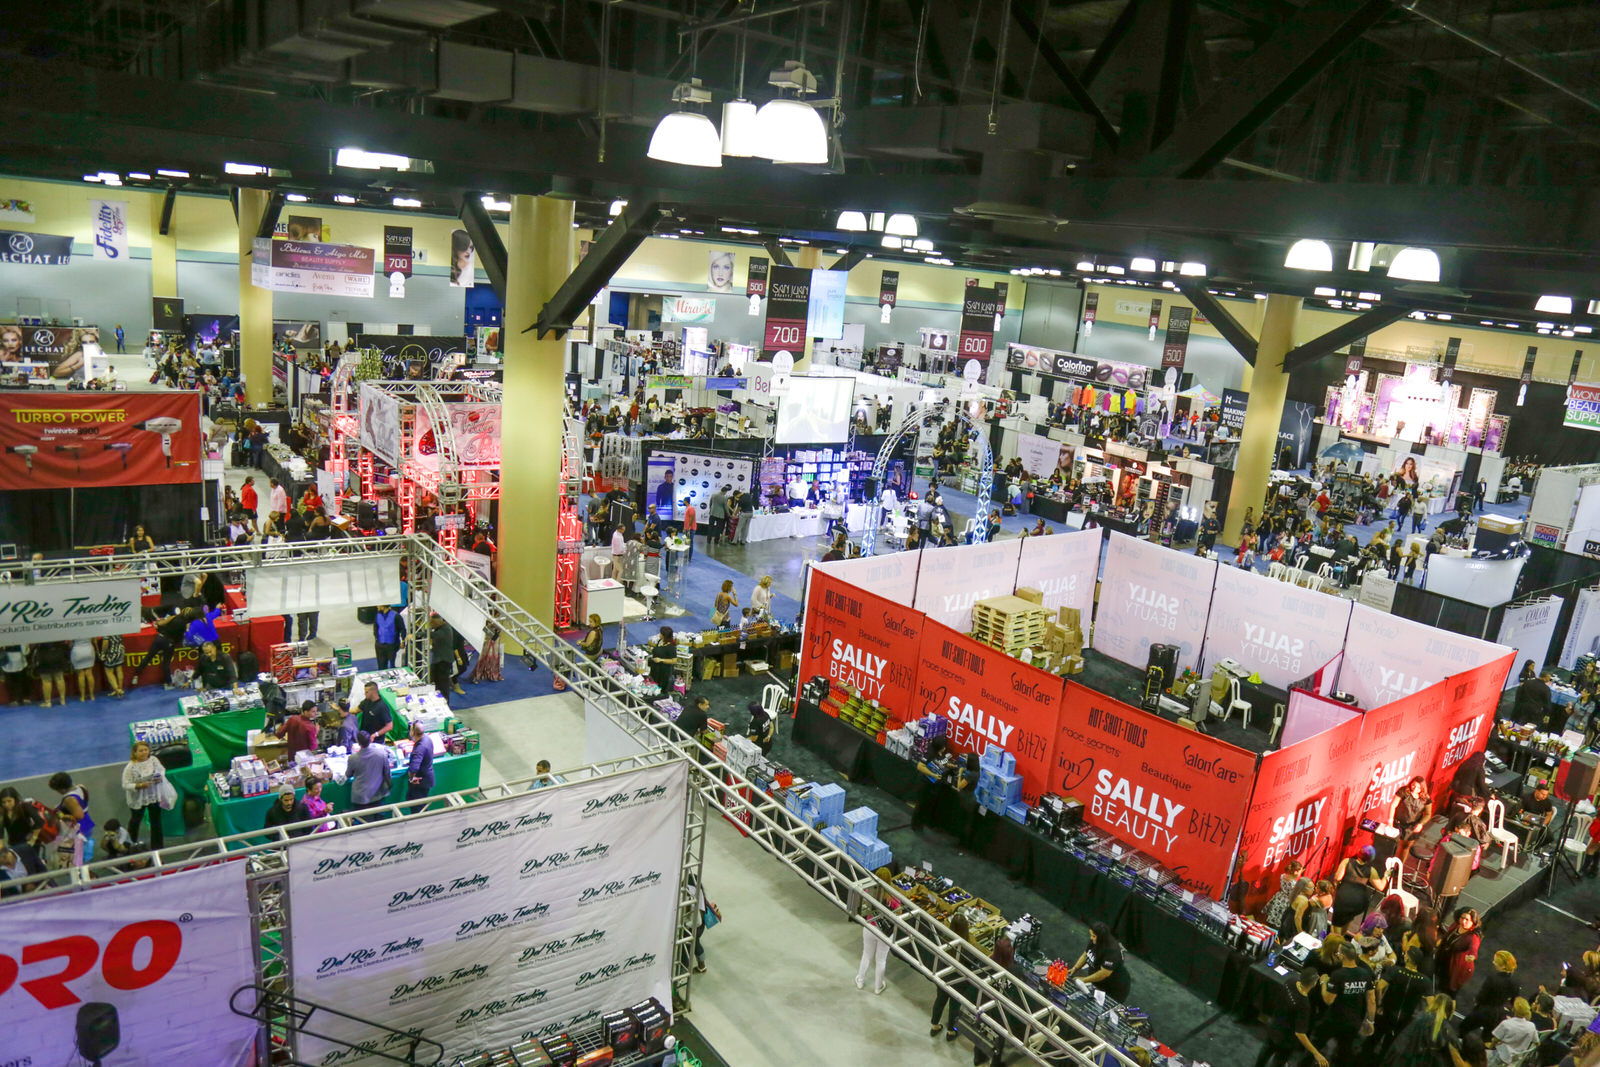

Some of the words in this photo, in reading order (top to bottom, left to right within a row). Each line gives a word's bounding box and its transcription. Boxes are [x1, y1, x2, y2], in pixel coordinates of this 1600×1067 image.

[96, 201, 118, 258] Fidelity
[0, 253, 51, 265] ECHAT
[389, 258, 408, 269] 700
[750, 283, 763, 292] 500
[772, 283, 790, 294] SAN
[772, 326, 800, 344] 700
[964, 337, 987, 353] 600
[1057, 358, 1092, 373] Colorina
[1166, 349, 1182, 362] 500
[1348, 360, 1361, 371] 400
[10, 409, 66, 423] TURBO
[71, 410, 126, 423] POWER
[1568, 399, 1600, 412] BEAU
[11, 599, 54, 625] Rio
[63, 594, 132, 618] Trading
[33, 621, 84, 631] Distributors
[85, 618, 108, 627] since
[111, 615, 133, 623] 1973
[1525, 605, 1551, 622] COLOR
[859, 628, 891, 649] Beautique
[831, 638, 888, 679] SALLY
[830, 660, 885, 699] BEAUTY
[1010, 672, 1052, 706] SalonCare
[981, 687, 1018, 714] Beautique
[947, 696, 1015, 747] SALLY
[1447, 713, 1485, 750] SALLY
[946, 719, 988, 757] BEAU
[1441, 735, 1478, 769] BEAUTY
[1141, 761, 1192, 792] Beautique
[1183, 744, 1238, 784] SalonCare
[1369, 751, 1416, 791] SALLY
[582, 796, 610, 813] Del
[609, 793, 629, 807] Rio
[633, 784, 667, 800] Trading
[1094, 767, 1186, 829] SALLY
[457, 824, 488, 842] Del
[488, 821, 511, 836] Rio
[514, 812, 552, 829] Trading
[1091, 794, 1179, 853] BEAUTY
[1269, 796, 1327, 844] SALLY
[313, 855, 349, 875] Del
[348, 851, 375, 867] Rio
[379, 841, 423, 860] Trading
[520, 856, 550, 874] Del
[548, 852, 570, 867] Rio
[574, 843, 609, 860] Trading
[1263, 824, 1322, 868] BEAUTY
[388, 887, 421, 907] Del
[420, 884, 445, 899] Rio
[449, 874, 490, 892] Trading
[578, 884, 606, 902] Del
[605, 881, 625, 895] Rio
[628, 871, 662, 888] Trading
[456, 916, 487, 936] Del
[486, 913, 509, 928] Rio
[513, 902, 550, 921] Trading
[317, 952, 351, 973] Del
[351, 948, 377, 965] Rio
[381, 937, 424, 957] Trading
[518, 944, 547, 963] Del
[546, 940, 567, 955] Rio
[571, 929, 606, 947] Trading
[389, 979, 422, 1000] Del
[420, 975, 445, 991] Rio
[449, 963, 489, 983] Trading
[575, 968, 602, 986] Del
[601, 963, 621, 978] Rio
[623, 952, 657, 970] Trading
[1344, 980, 1367, 990] SALLY
[456, 1004, 486, 1024] Del
[485, 1000, 507, 1015] Rio
[511, 988, 548, 1007] Trading
